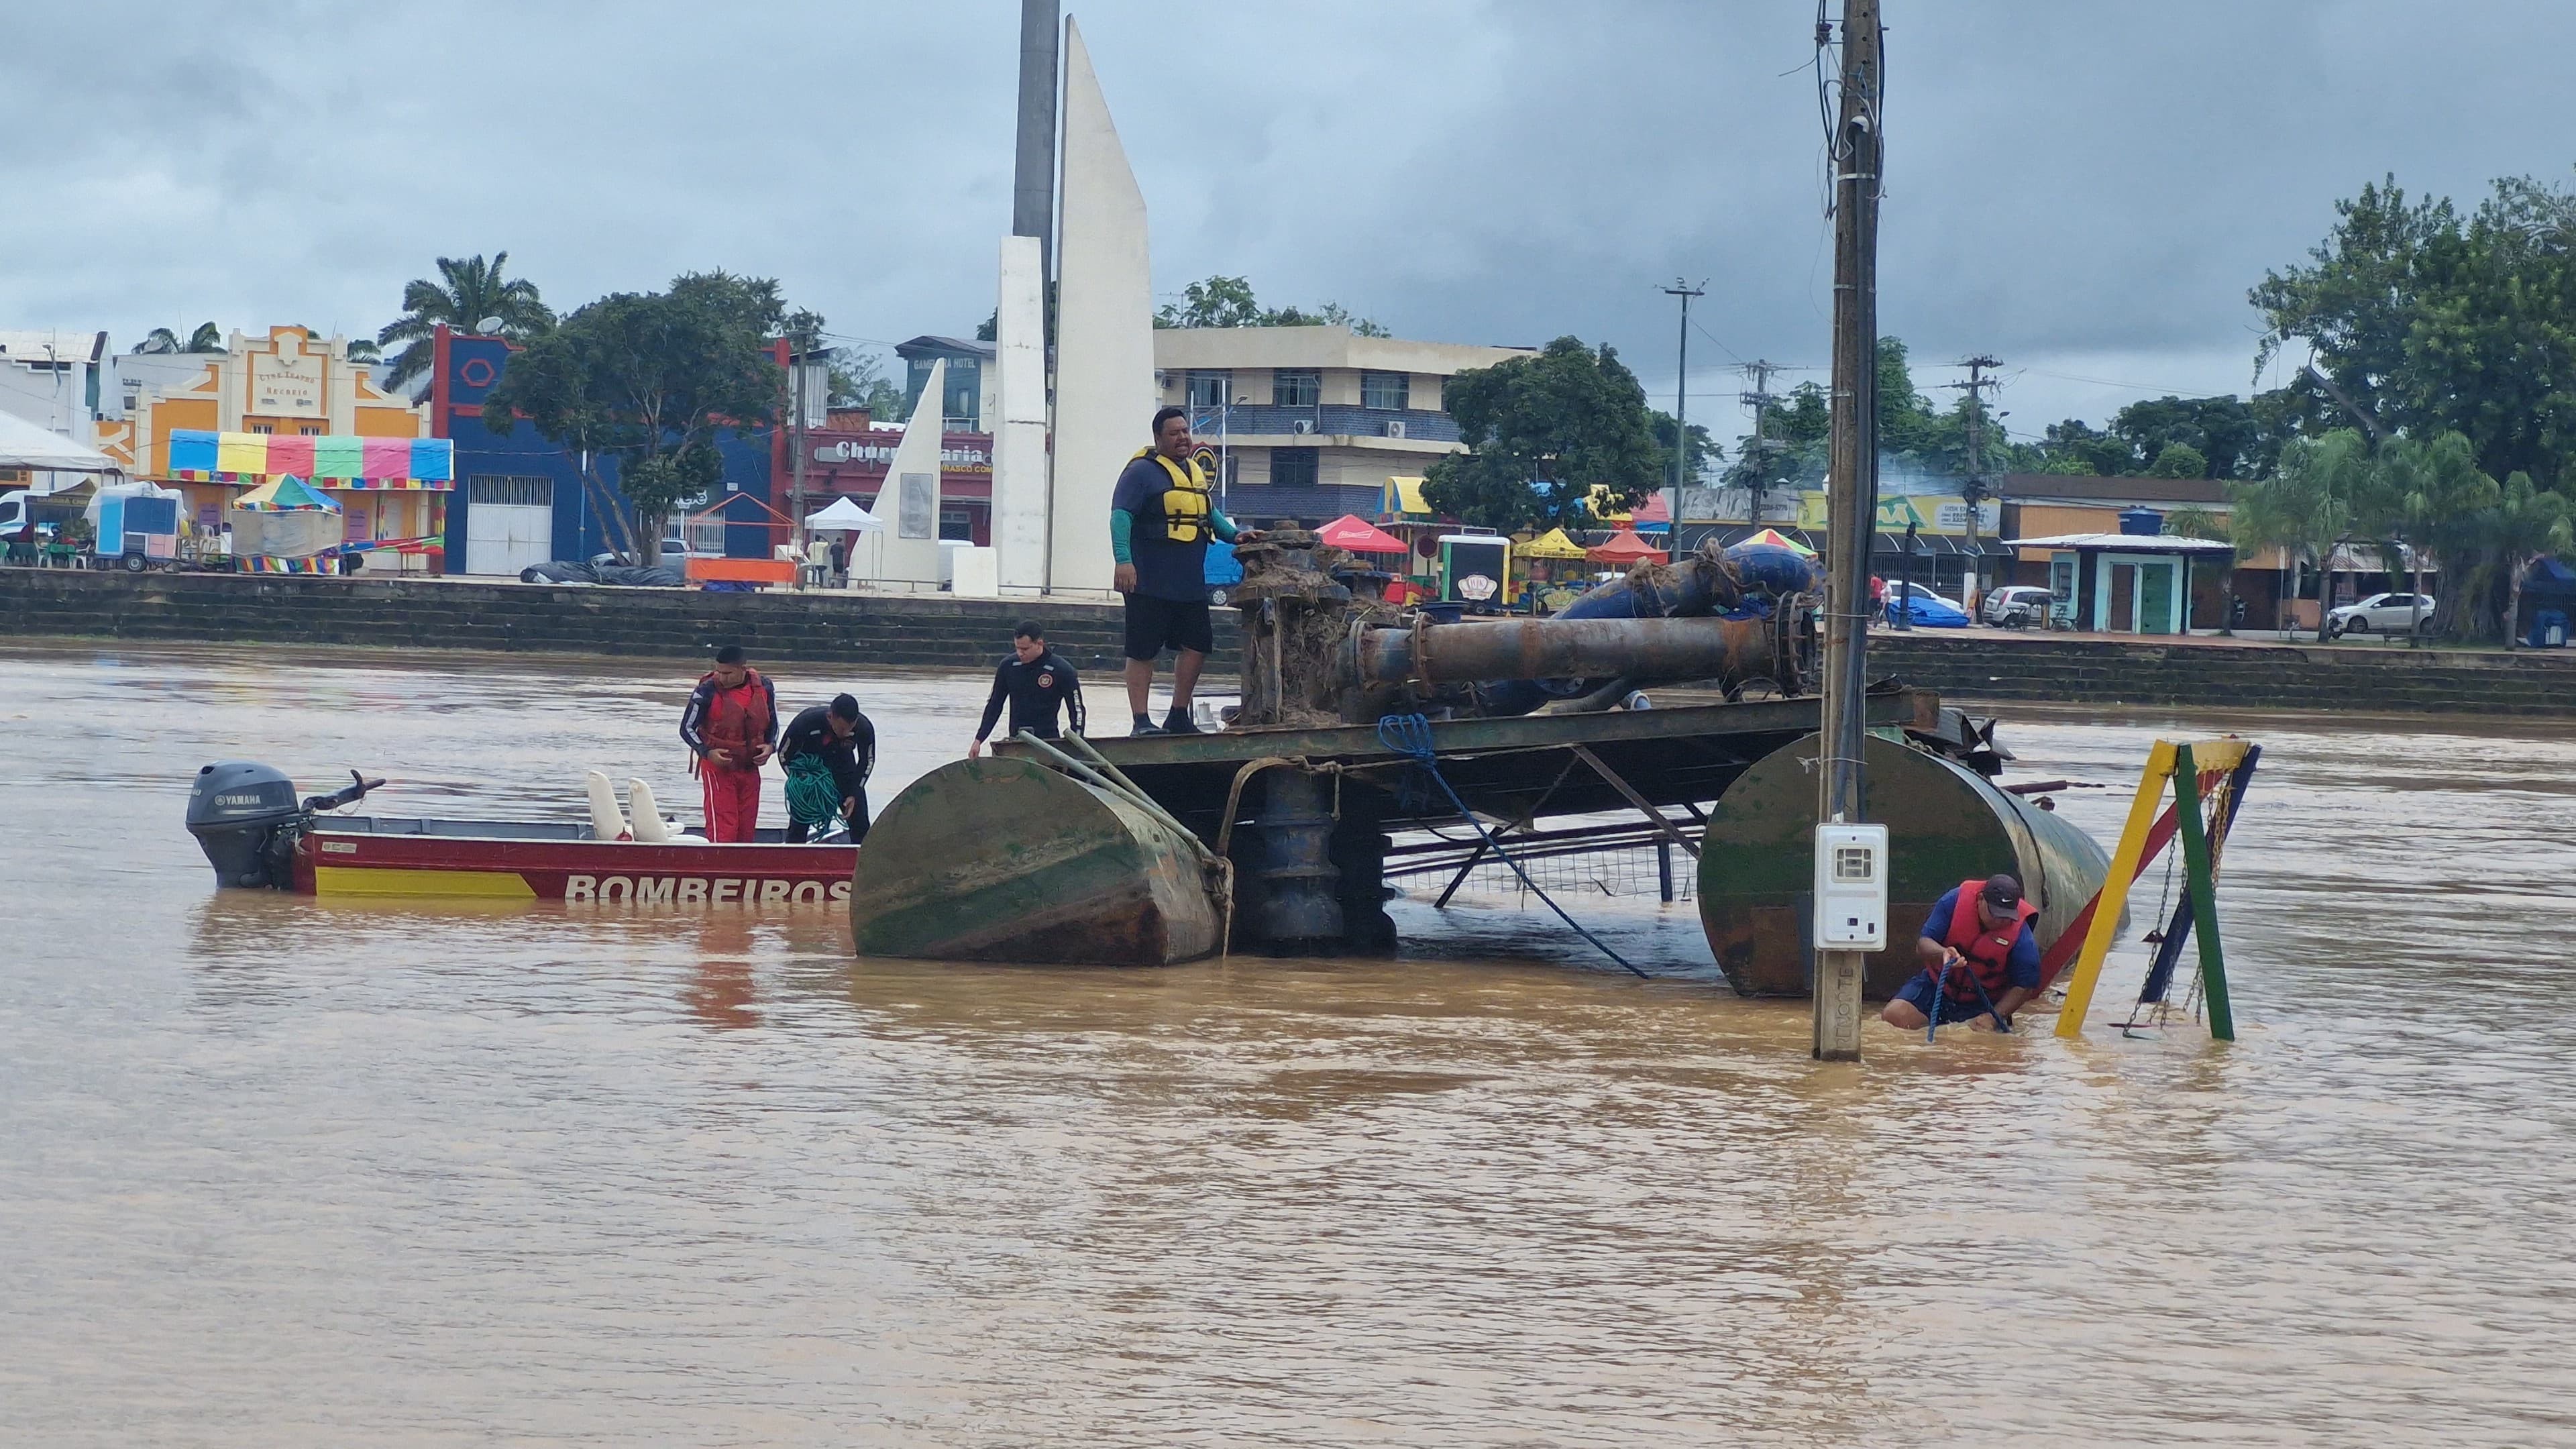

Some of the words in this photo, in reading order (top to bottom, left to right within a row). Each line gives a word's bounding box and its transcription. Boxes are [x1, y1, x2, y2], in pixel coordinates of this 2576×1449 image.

[954, 358, 975, 368] HOTEL
[836, 441, 983, 462] Churraria
[226, 795, 261, 805] YAMAHA
[565, 875, 851, 901] BOMBEIROS
